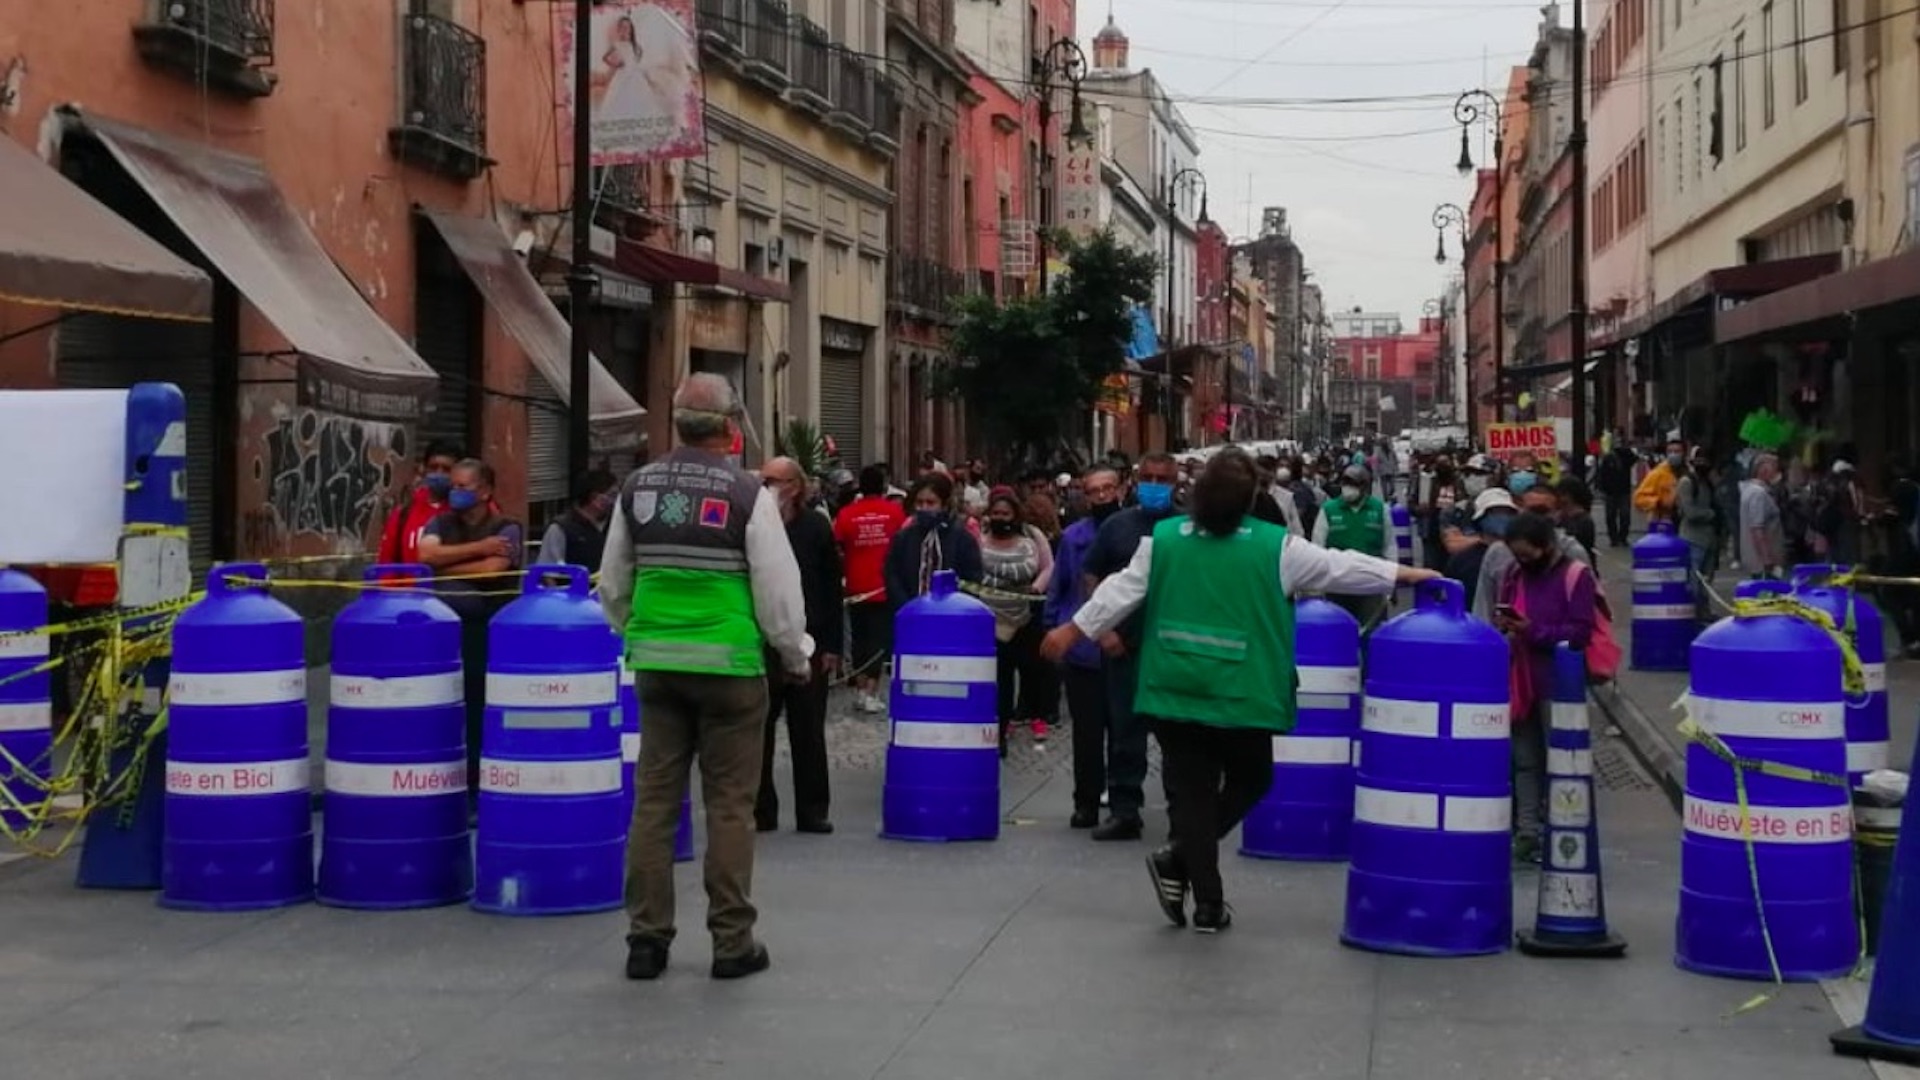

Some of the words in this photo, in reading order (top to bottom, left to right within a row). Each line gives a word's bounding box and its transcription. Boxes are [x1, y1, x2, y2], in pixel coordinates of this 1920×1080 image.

[528, 683, 570, 696] CDMX
[1779, 711, 1822, 725] CDMX
[198, 773, 224, 789] en
[232, 767, 274, 789] Bici
[1796, 819, 1824, 837] en
